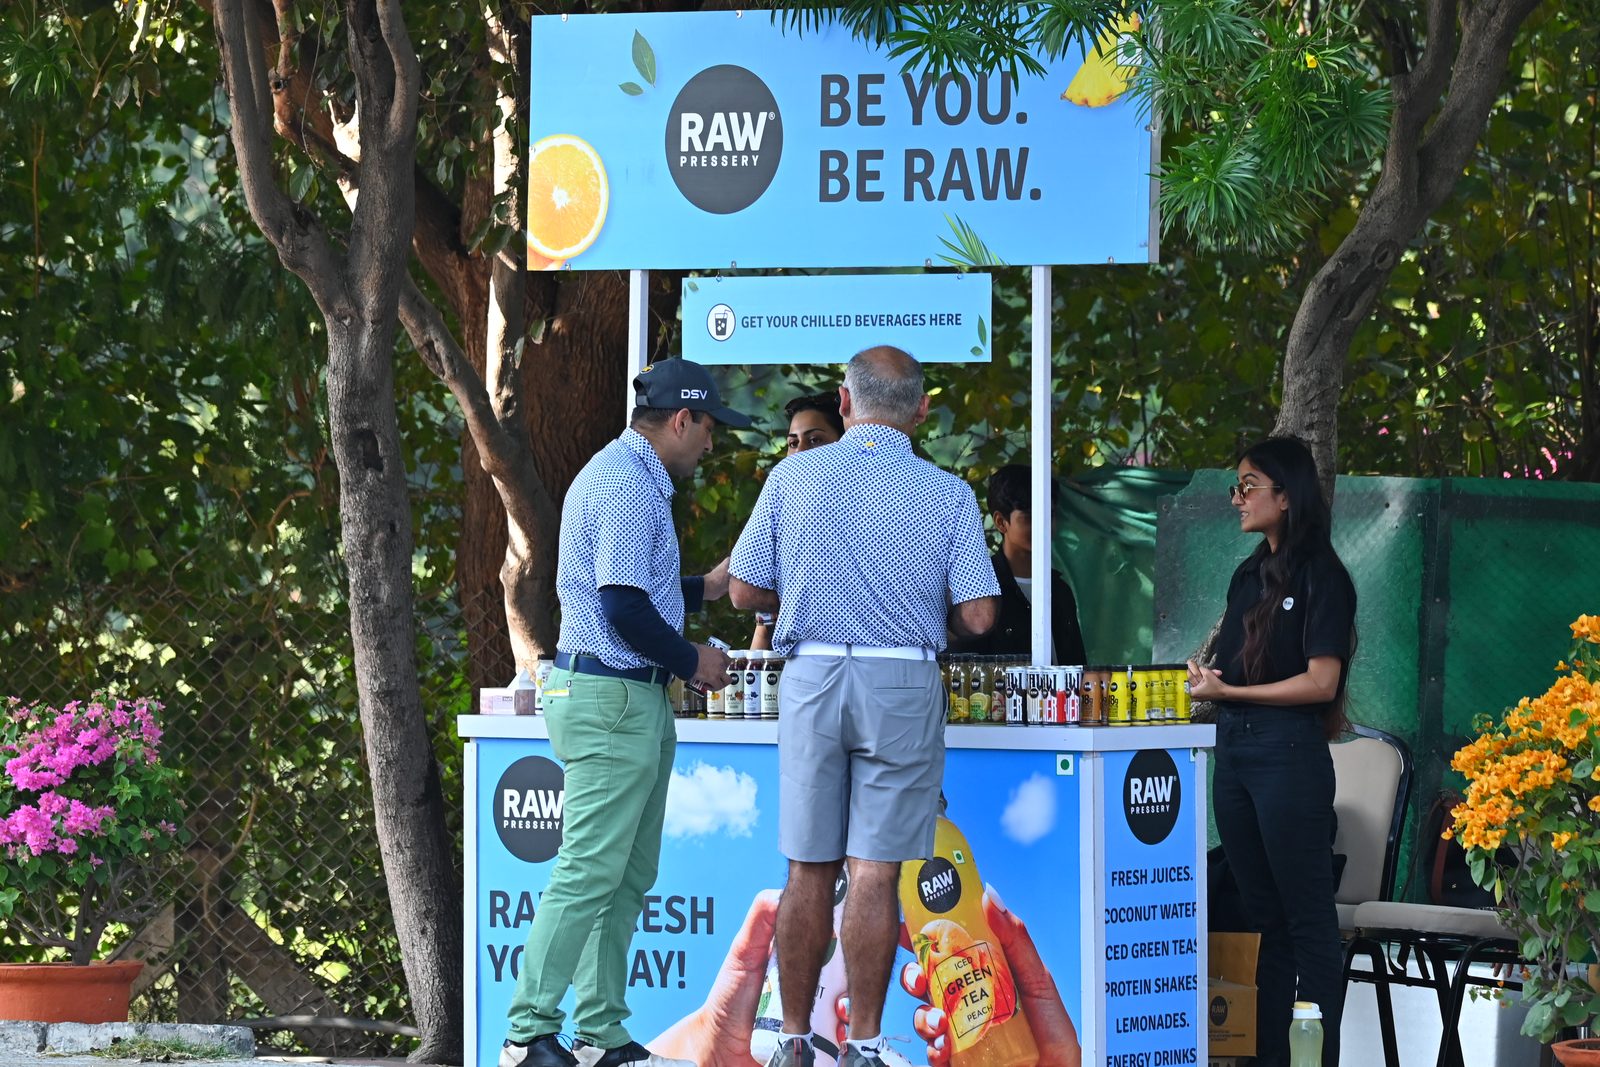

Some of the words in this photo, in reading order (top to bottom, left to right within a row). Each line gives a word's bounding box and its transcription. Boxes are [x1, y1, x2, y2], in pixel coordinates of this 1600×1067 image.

[820, 73, 886, 127] BE
[902, 71, 1028, 126] YOU.
[680, 155, 759, 167] PRESSERY
[819, 149, 885, 203] BE
[903, 147, 1042, 202] RAW.
[741, 316, 764, 328] GET
[766, 315, 798, 328] YOUR
[801, 314, 852, 328] CHILLED
[855, 314, 926, 327] BEVERAGES
[929, 313, 962, 326] HERE
[681, 389, 708, 400] DSV
[503, 788, 564, 819] RAW
[1130, 804, 1170, 815] PRESSERY
[503, 820, 560, 830] PRESSERY
[921, 868, 953, 897] RAW
[1111, 869, 1148, 887] FRESH
[1151, 866, 1193, 884] JUICES.
[489, 890, 543, 929] RA
[632, 895, 714, 935] ESH
[1105, 905, 1157, 924] COCONUT
[1105, 943, 1129, 961] CED
[1131, 940, 1169, 959] GREEN
[628, 949, 686, 989] AY!
[954, 956, 973, 971] ICED
[946, 965, 992, 996] GREEN
[1105, 979, 1151, 997] PROTEIN
[1154, 975, 1197, 993] SHAKES
[961, 986, 989, 1008] TEA
[967, 1004, 994, 1022] PEACH
[1116, 1012, 1190, 1034] LEMONADES.
[1106, 1052, 1151, 1067] ENERGY
[1154, 1047, 1197, 1067] DRINKS
